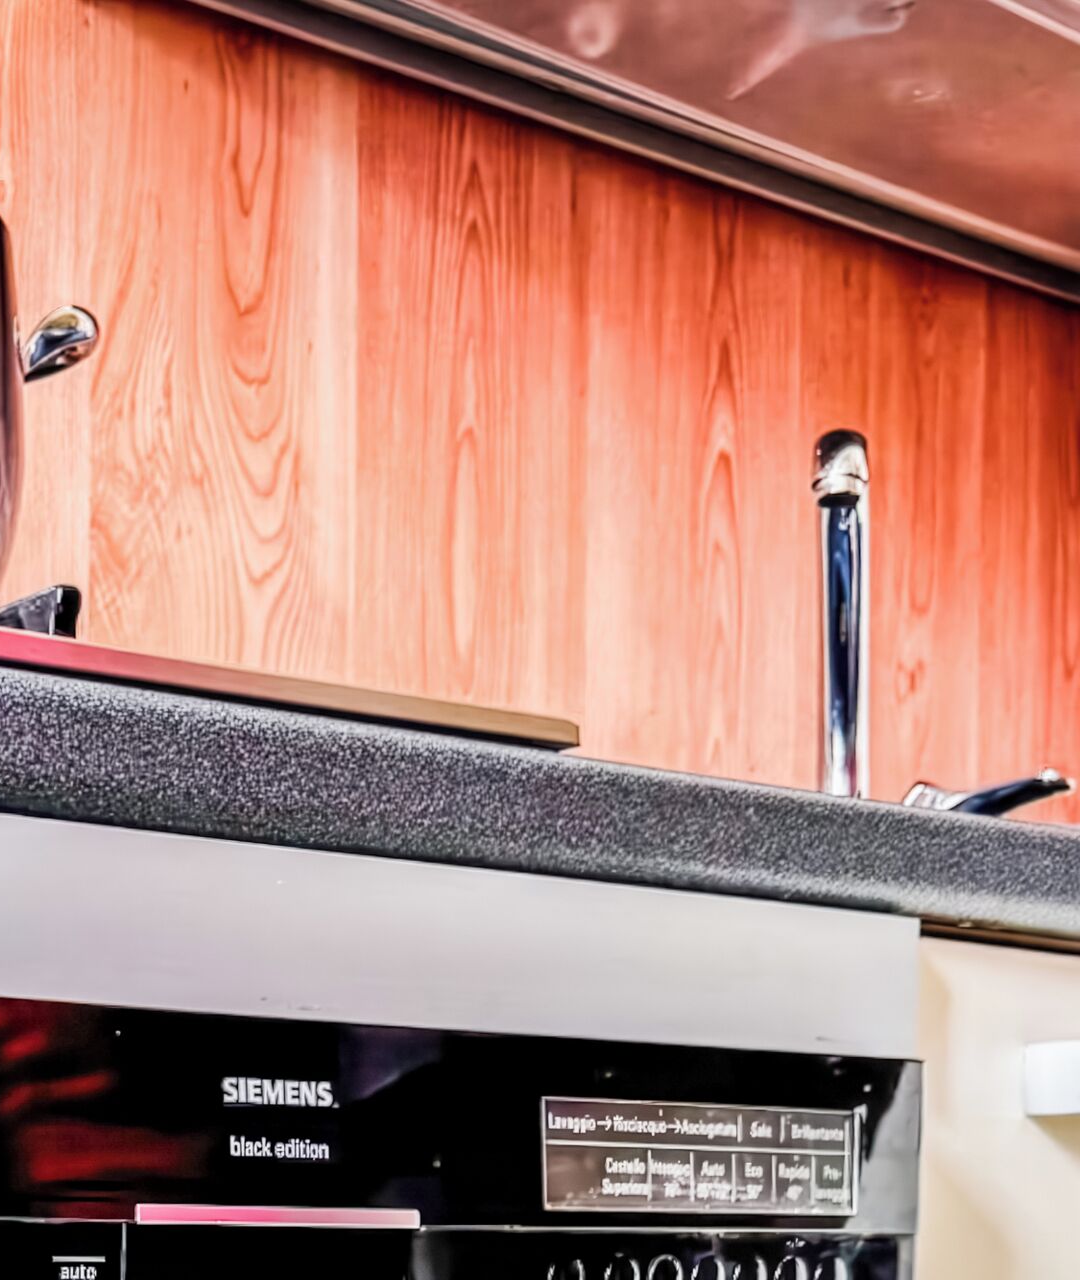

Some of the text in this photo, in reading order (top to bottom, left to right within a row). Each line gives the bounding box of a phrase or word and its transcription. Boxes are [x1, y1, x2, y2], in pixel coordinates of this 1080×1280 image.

[221, 1077, 334, 1107] SIEMENS
[230, 1135, 330, 1160] black edition
[59, 1264, 97, 1280] auto
